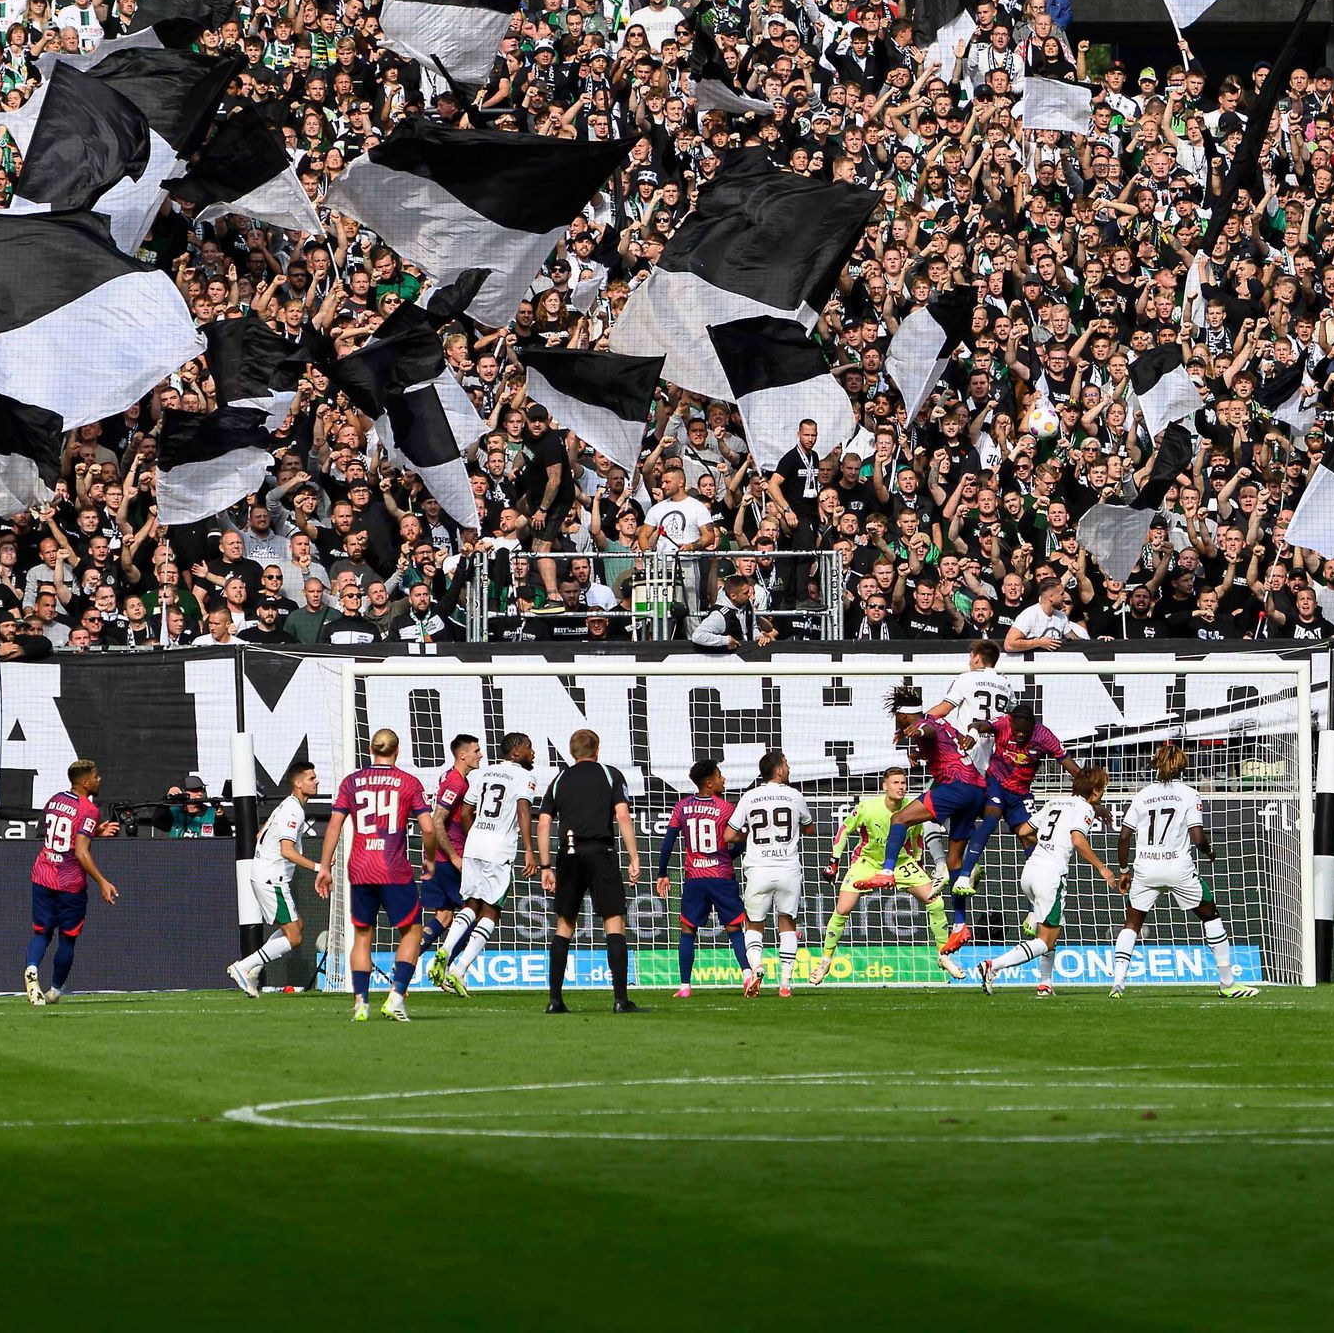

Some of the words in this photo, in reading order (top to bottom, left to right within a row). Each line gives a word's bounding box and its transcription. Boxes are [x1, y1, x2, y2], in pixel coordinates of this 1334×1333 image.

[355, 777, 367, 787] RB
[368, 776, 402, 788] LEIPZIG
[355, 789, 399, 835] 24
[479, 782, 507, 819] 13
[683, 806, 693, 815] RB
[694, 806, 720, 817] LEIPZIG
[44, 813, 73, 853] 39
[686, 818, 718, 854] 18
[749, 806, 793, 845] 29
[1040, 809, 1062, 842] 3
[1147, 808, 1177, 847] 17
[365, 838, 385, 851] XAVER
[761, 848, 789, 858] SCALLY
[1139, 851, 1160, 861] MANU
[899, 861, 920, 878] 33
[860, 961, 894, 978] .de
[1033, 950, 1203, 979] ONGEN
